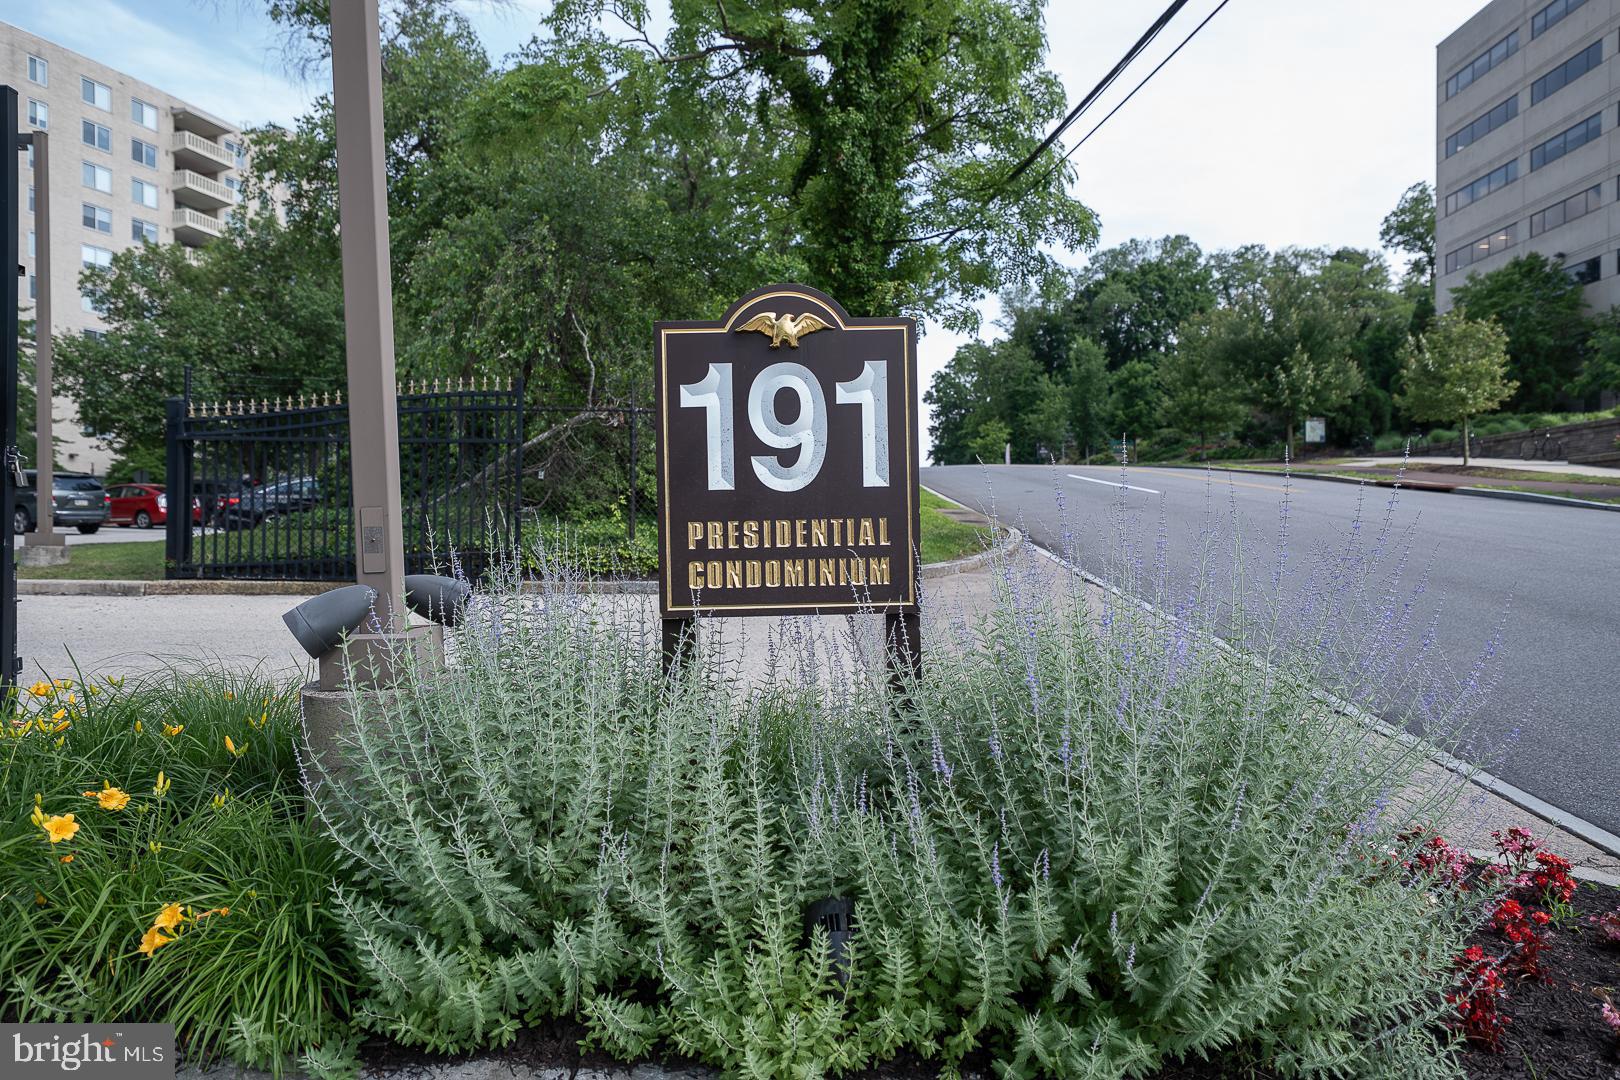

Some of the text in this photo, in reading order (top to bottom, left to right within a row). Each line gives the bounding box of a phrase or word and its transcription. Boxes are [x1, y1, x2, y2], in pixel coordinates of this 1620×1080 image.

[680, 360, 890, 492] 191
[687, 517, 891, 550] PRESIDENTIAL
[688, 556, 890, 589] CONDOMINIUM
